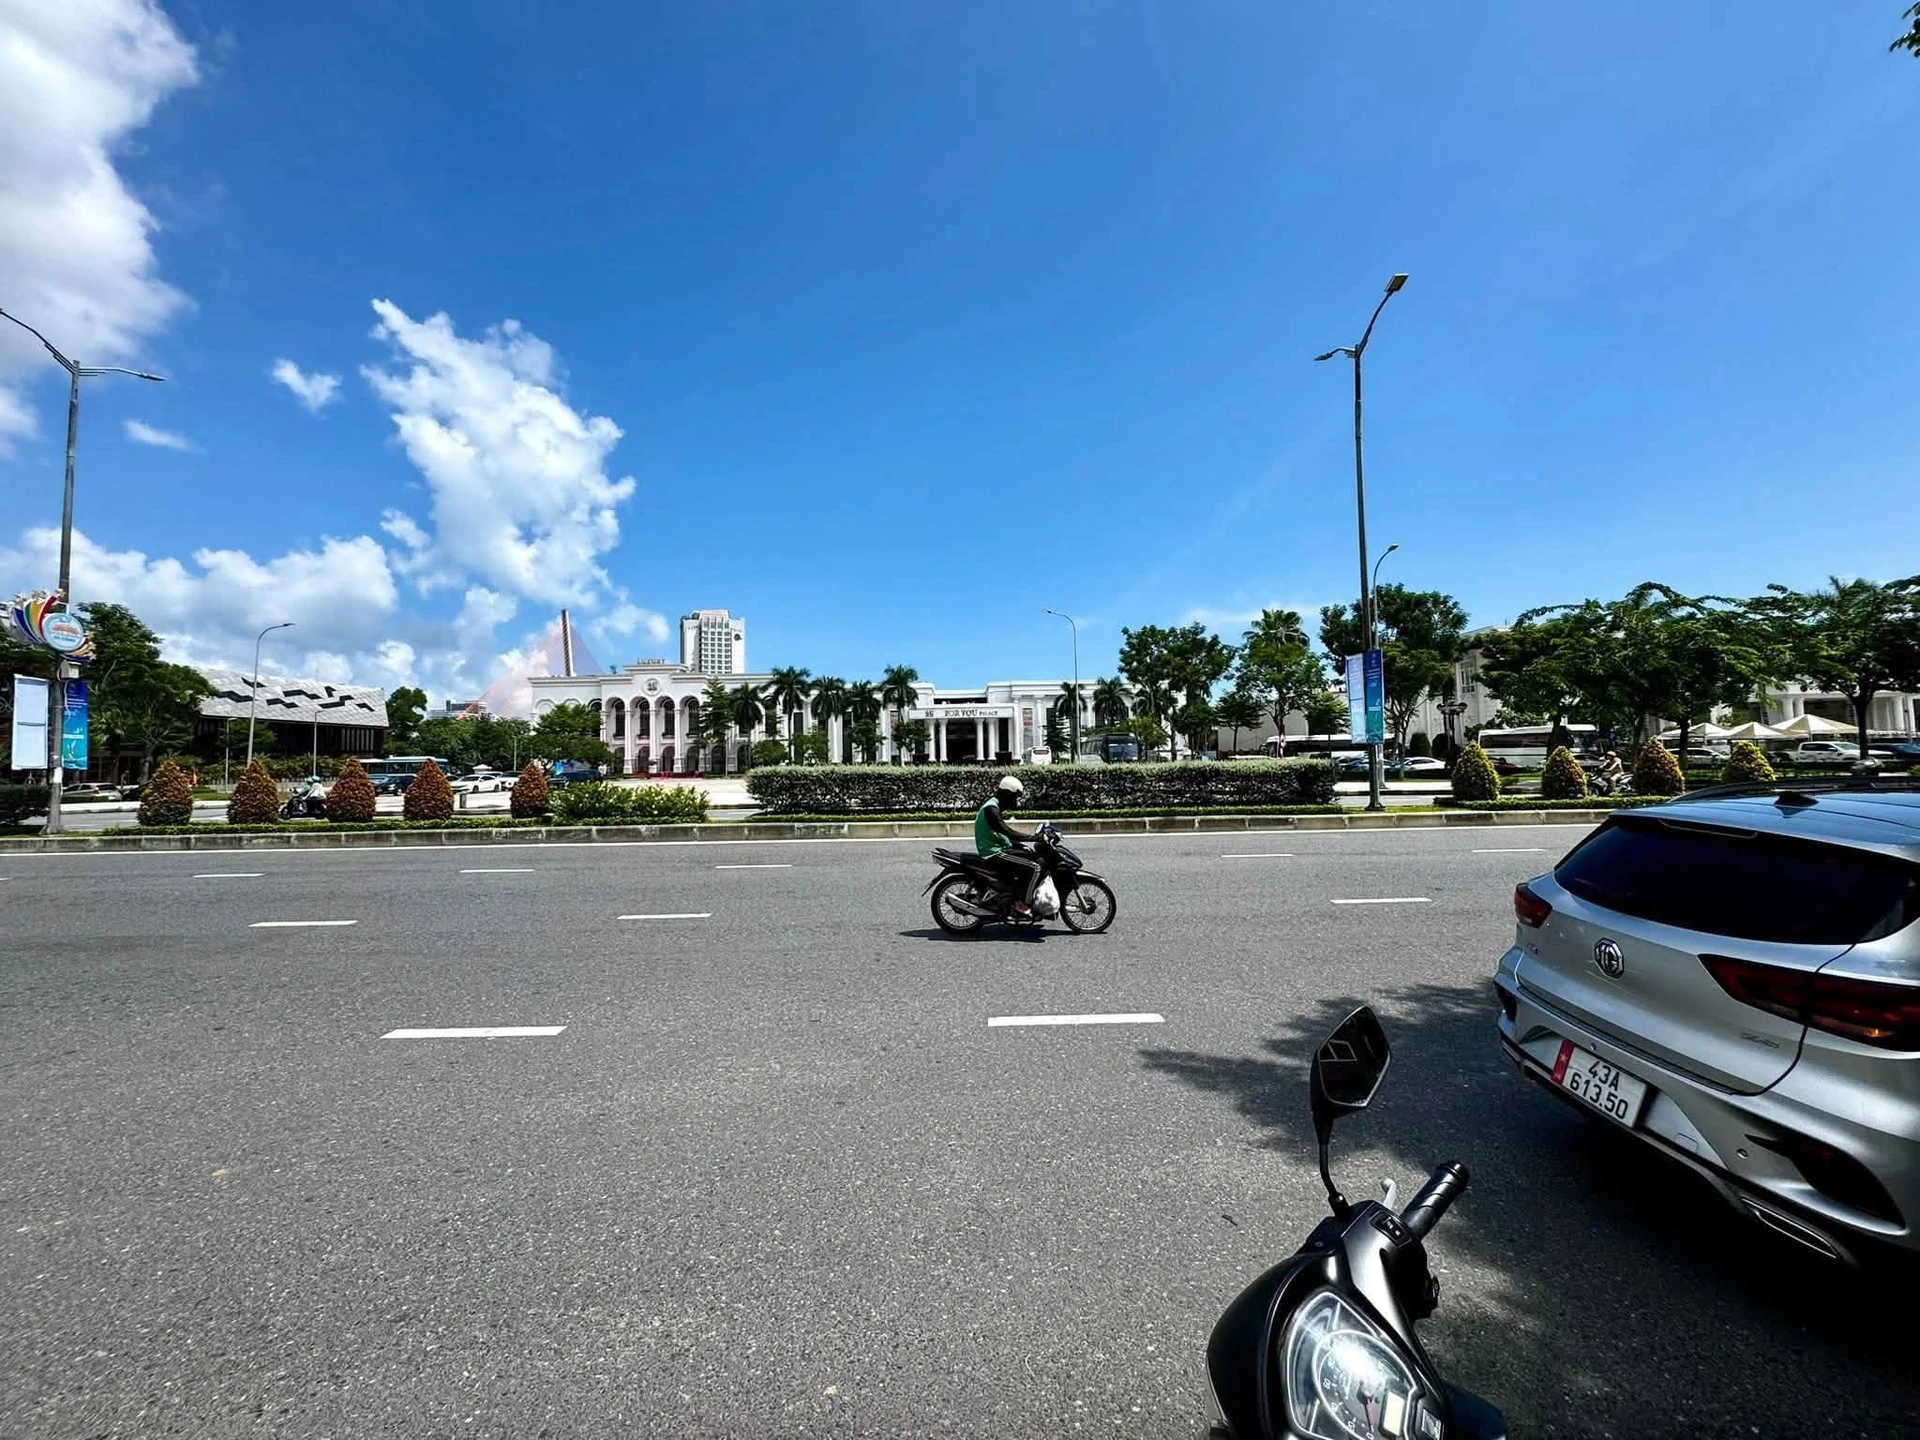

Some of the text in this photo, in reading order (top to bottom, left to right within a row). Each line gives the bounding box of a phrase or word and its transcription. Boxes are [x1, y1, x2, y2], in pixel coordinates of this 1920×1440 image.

[960, 709, 978, 717] YOU
[1588, 1060, 1621, 1092] 43A
[1569, 1072, 1629, 1120] 613.50
